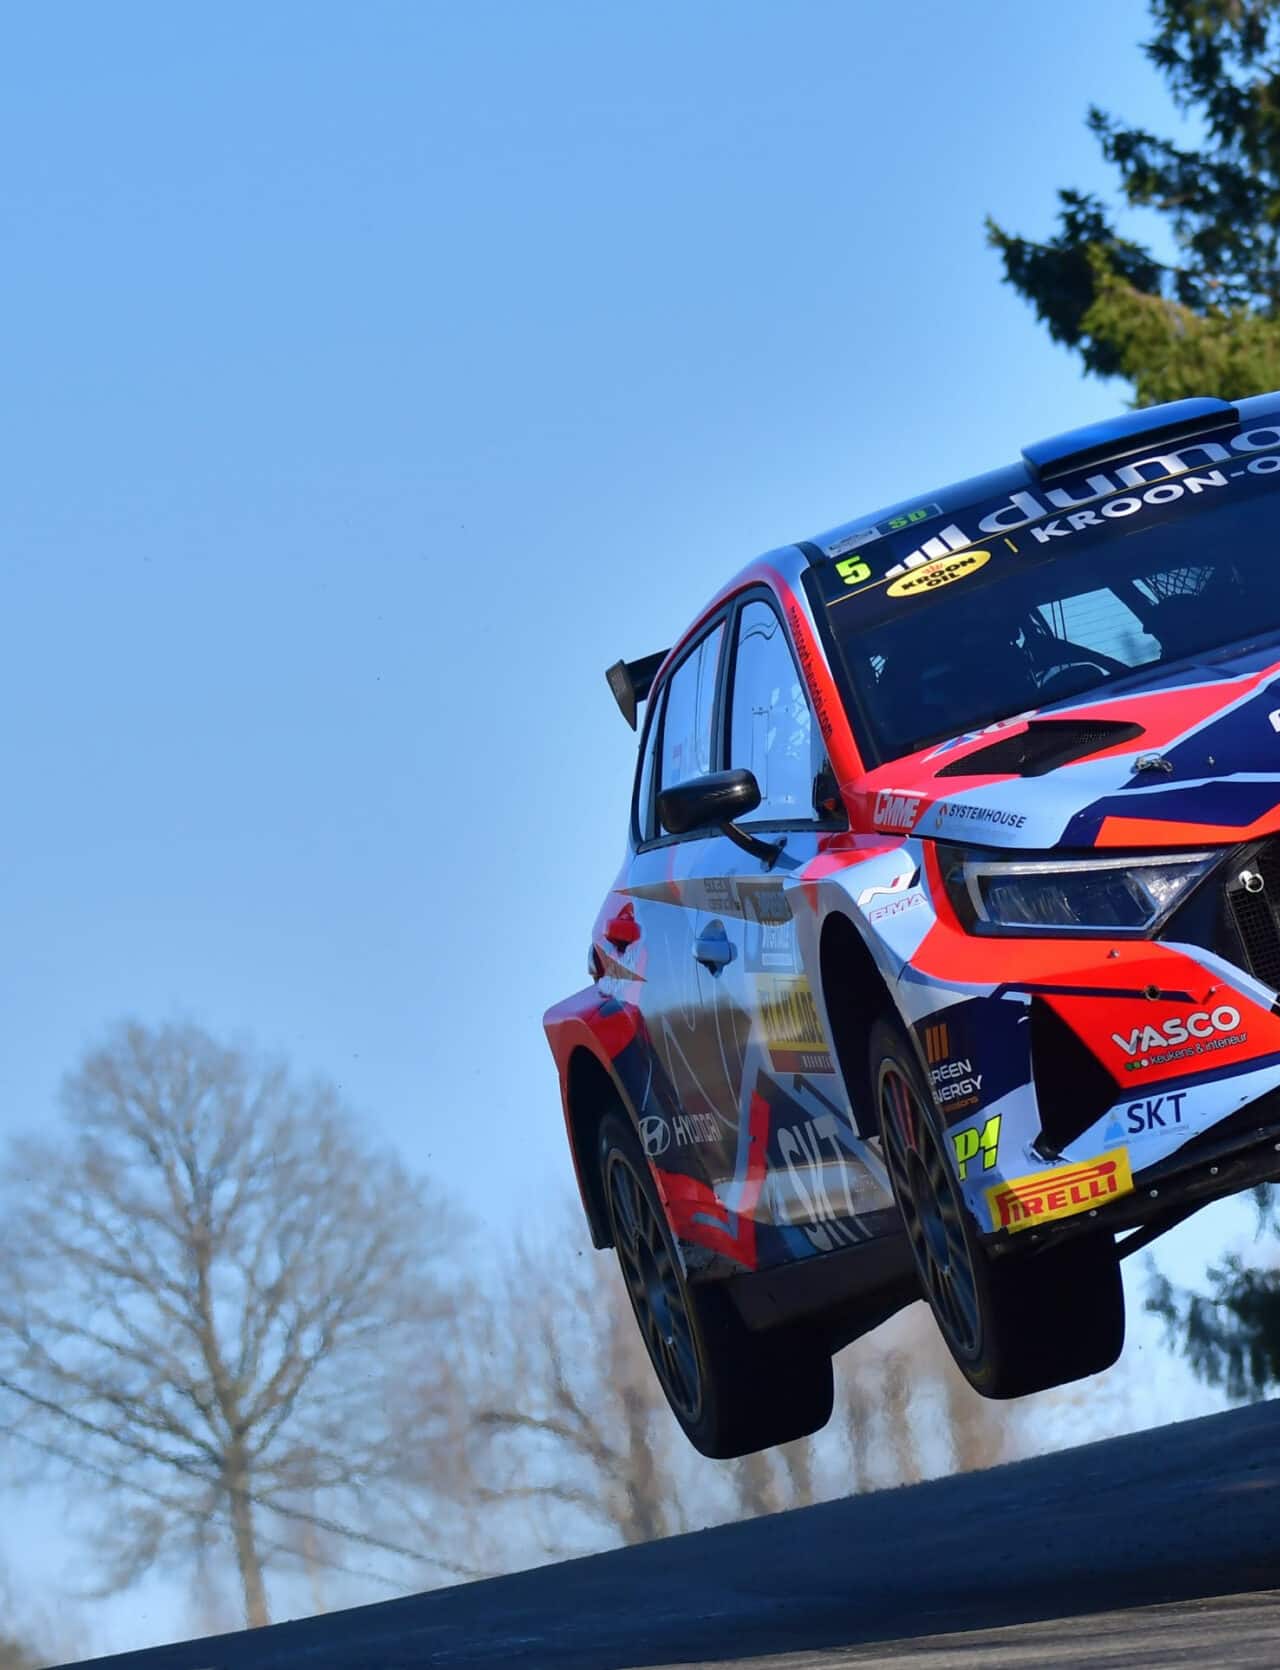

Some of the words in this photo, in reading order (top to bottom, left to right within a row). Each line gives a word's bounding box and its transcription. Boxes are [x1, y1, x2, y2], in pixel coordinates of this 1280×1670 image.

[835, 555, 872, 585] 5
[902, 557, 976, 590] KROON
[926, 572, 960, 587] OIL
[949, 803, 1027, 829] SYSTEMHOUSE
[1112, 1006, 1241, 1056] VASCO
[1150, 1047, 1194, 1064] keukens
[1195, 1044, 1204, 1053] &
[1205, 1032, 1248, 1051] interieur
[928, 1058, 972, 1086] REEN
[933, 1074, 983, 1104] NERGY
[1127, 1092, 1187, 1134] SKT
[952, 1113, 1002, 1182] P1
[777, 1114, 873, 1252] SKT
[994, 1160, 1118, 1227] PIRELLI
